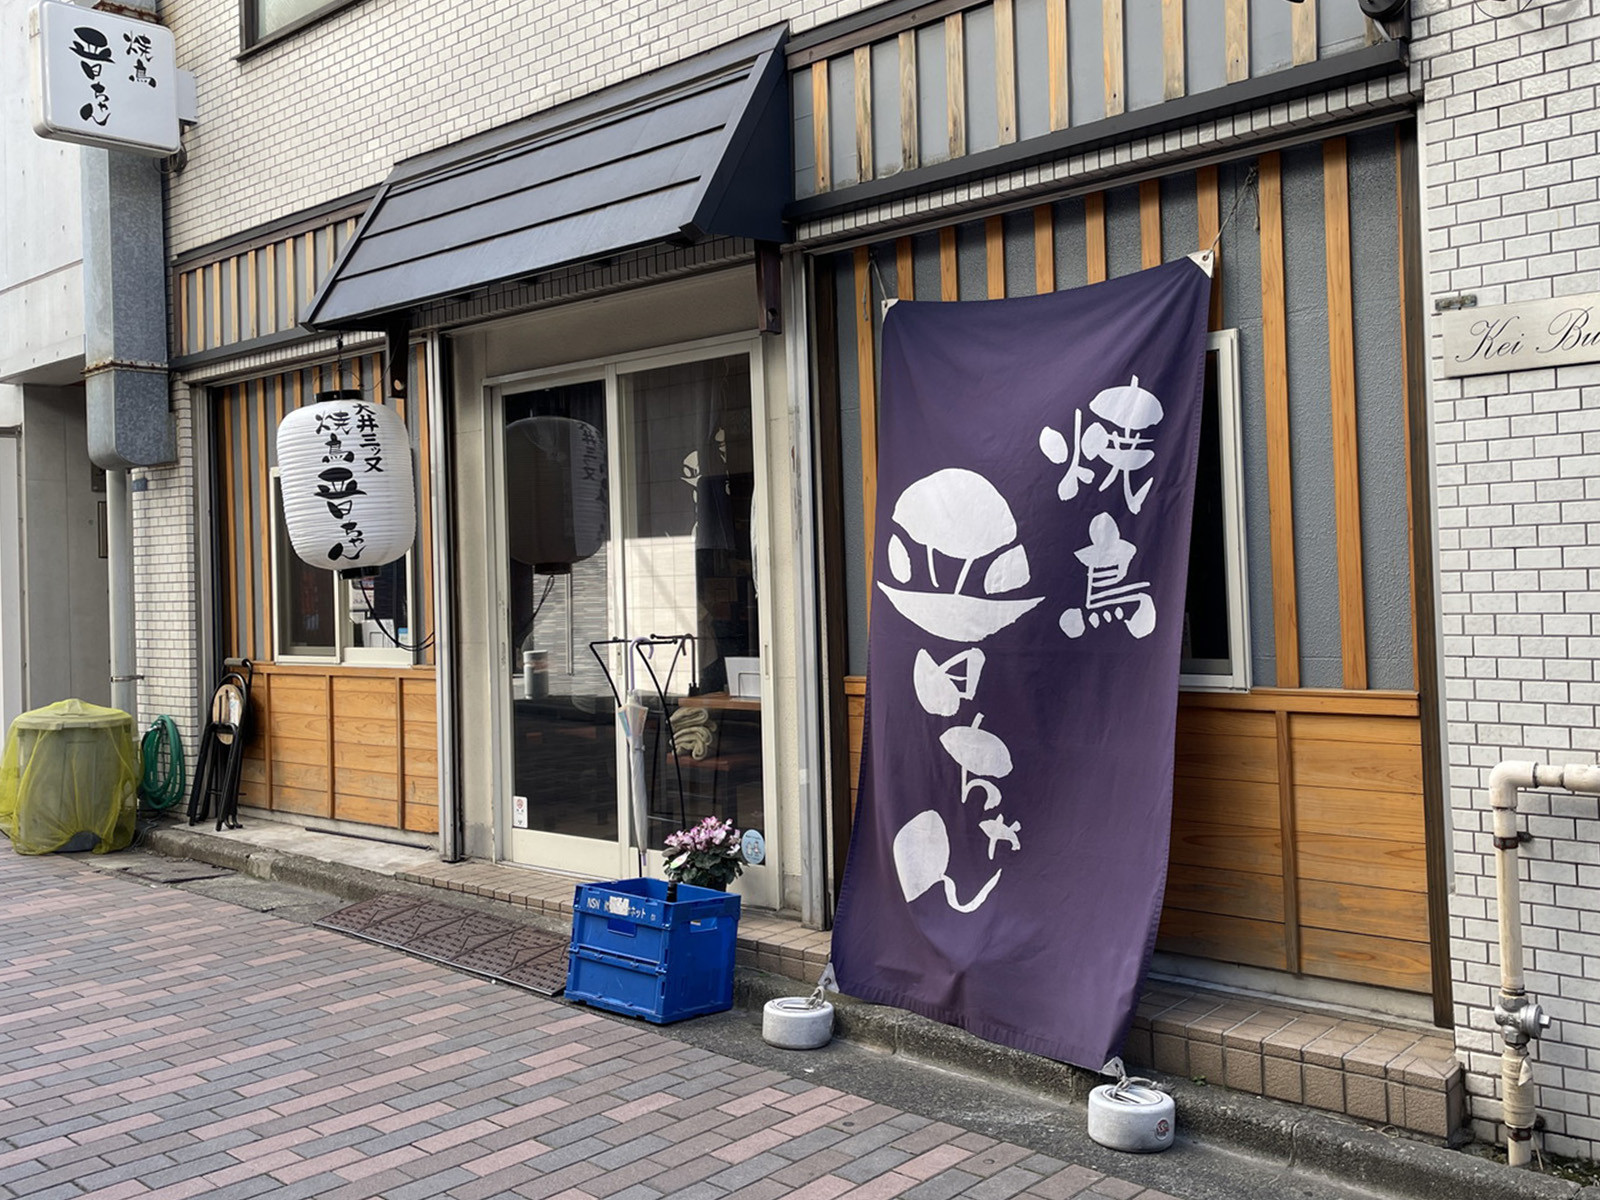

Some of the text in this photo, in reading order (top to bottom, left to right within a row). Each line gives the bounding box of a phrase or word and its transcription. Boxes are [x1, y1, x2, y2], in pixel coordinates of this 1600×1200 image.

[123, 31, 157, 88] 焼鳥
[1455, 316, 1525, 363] Kei
[1039, 375, 1164, 639] 焼鳥
